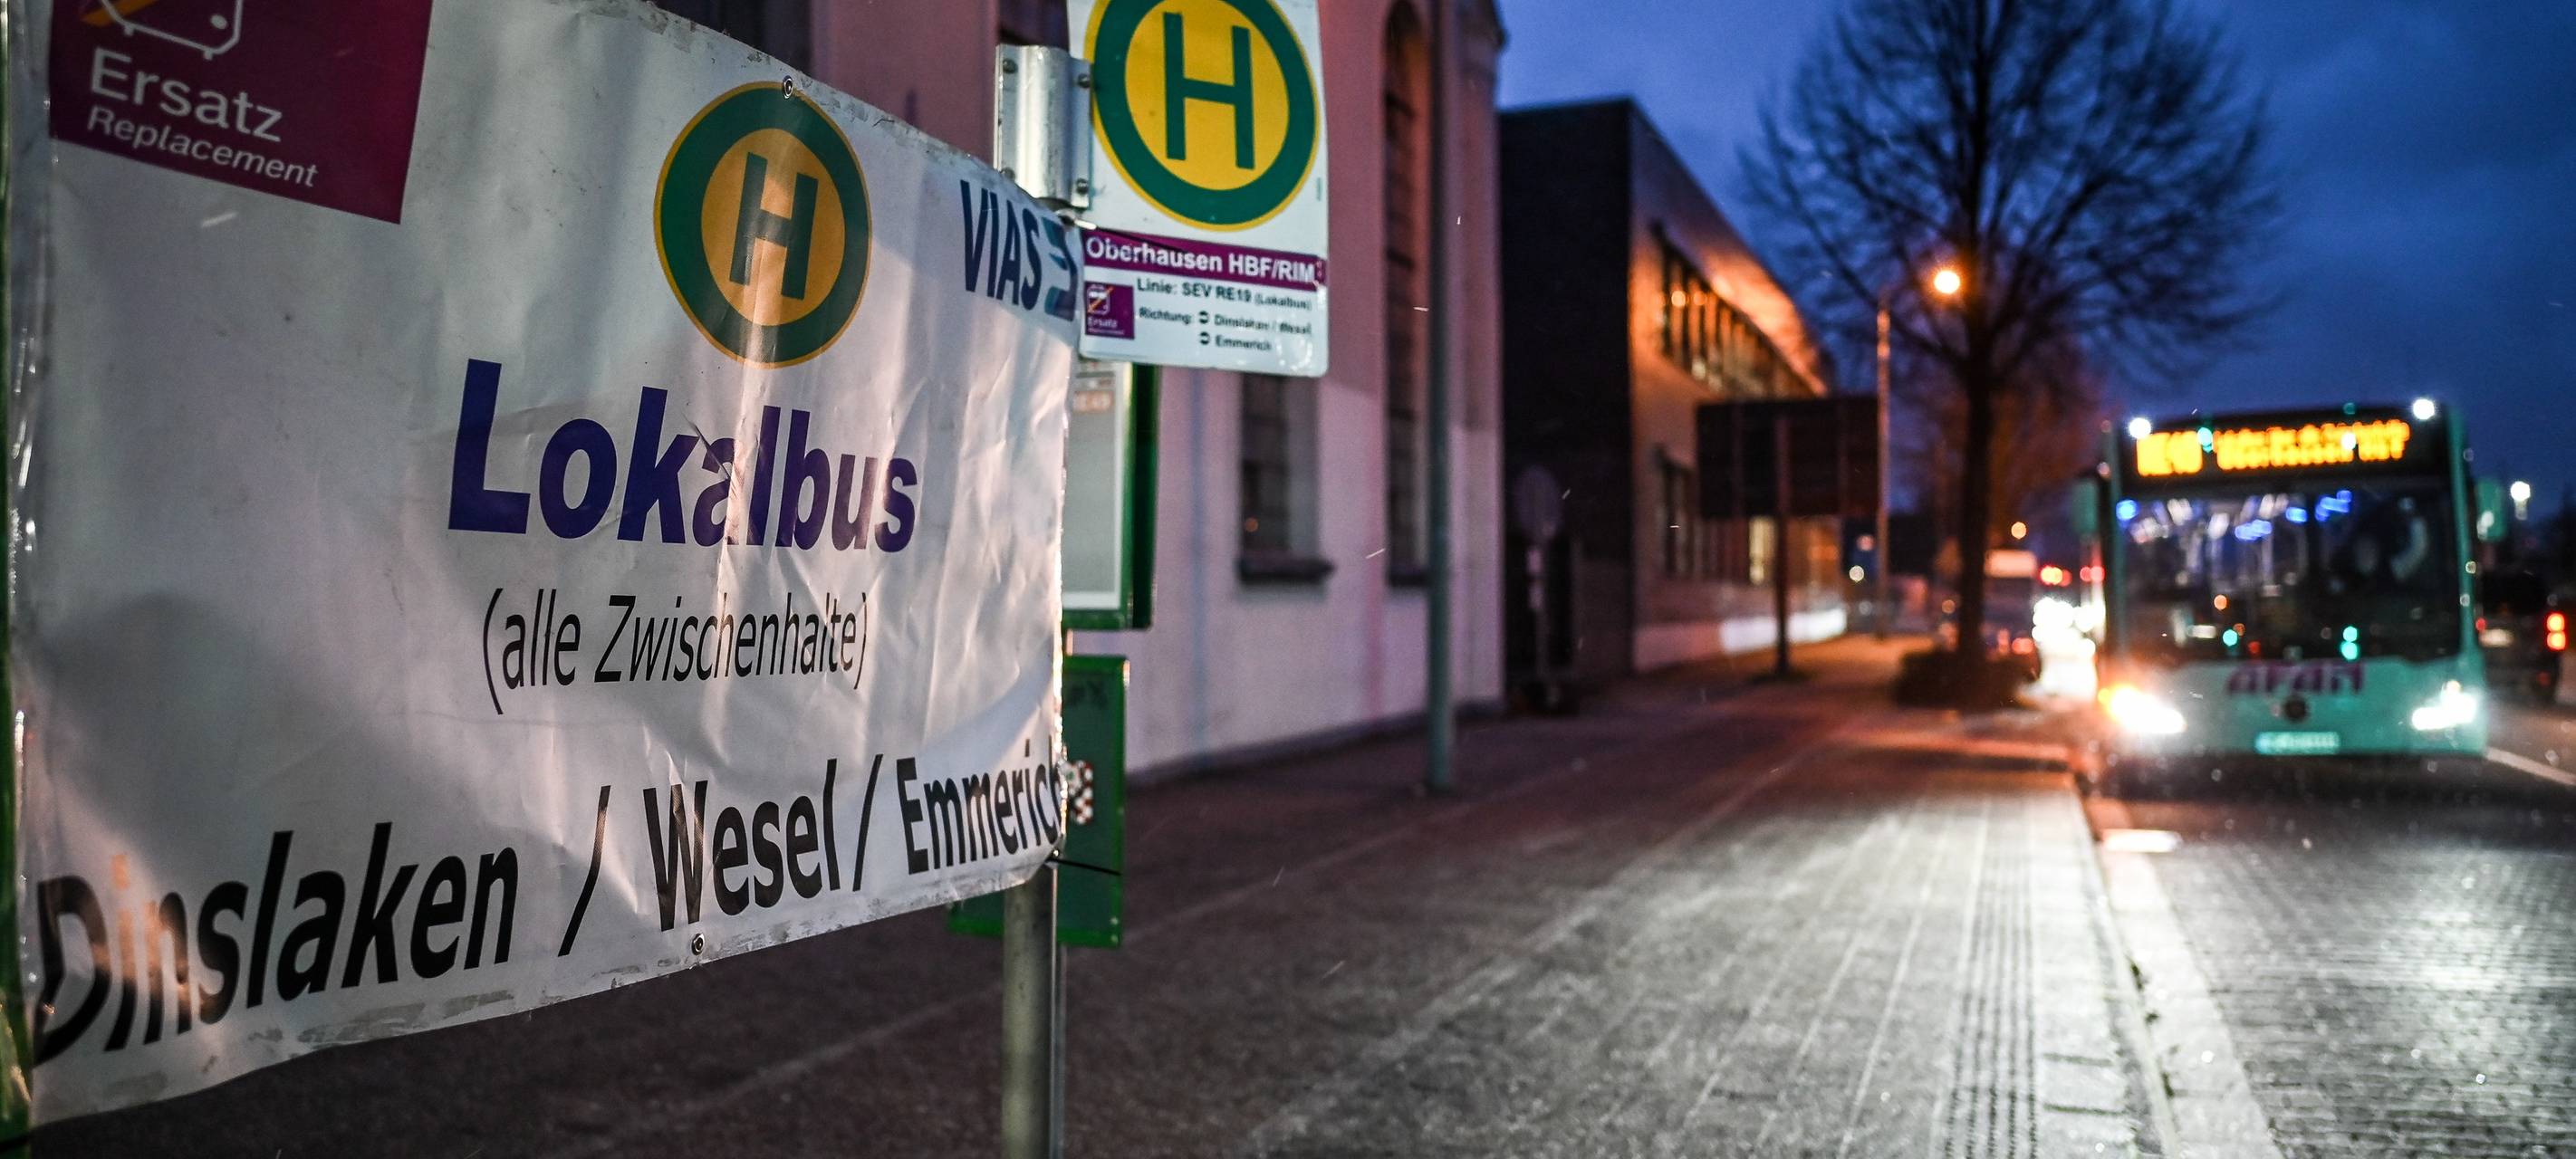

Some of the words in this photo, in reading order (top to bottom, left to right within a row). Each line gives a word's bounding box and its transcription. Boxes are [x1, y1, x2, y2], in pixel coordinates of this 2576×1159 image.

[87, 104, 318, 187] Replacement
[91, 46, 284, 142] Ersatz
[1163, 12, 1255, 170] H
[729, 151, 819, 301] H
[960, 179, 1042, 311] VIAS
[1086, 235, 1223, 272] Oberhausen
[1181, 282, 1212, 298] SEV
[1216, 285, 1252, 302] RE19
[448, 359, 918, 552] Lokalbus
[483, 588, 582, 715] (alle
[593, 591, 868, 691] Zwischenhalte)
[33, 821, 519, 1066] Dinslaken
[642, 758, 841, 932] Wesel
